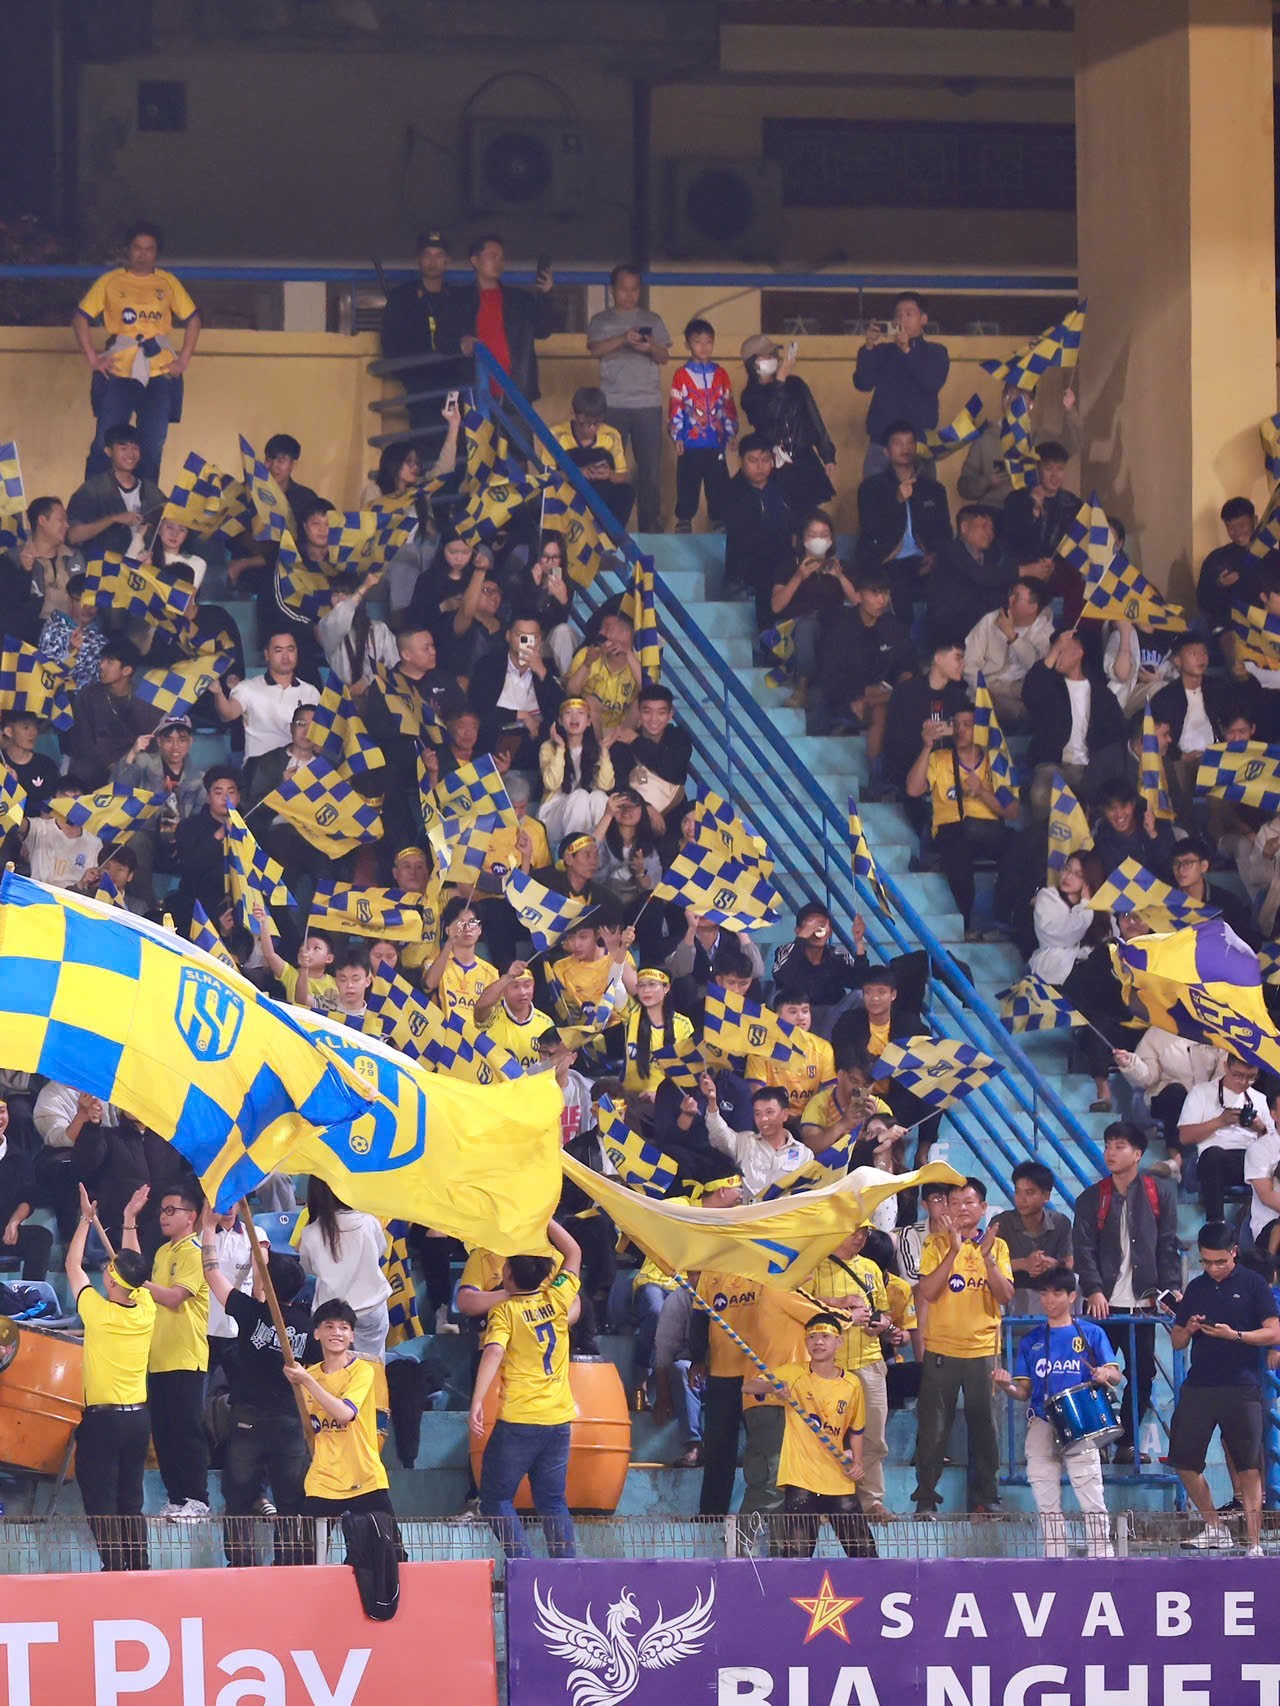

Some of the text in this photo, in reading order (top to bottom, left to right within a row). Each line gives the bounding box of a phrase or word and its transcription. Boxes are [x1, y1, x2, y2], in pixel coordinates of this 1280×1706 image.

[185, 970, 222, 990] SLNA
[729, 1292, 756, 1305] AAN
[534, 1321, 558, 1376] 7
[1052, 1359, 1081, 1371] AAN
[1139, 1422, 1162, 1454] A
